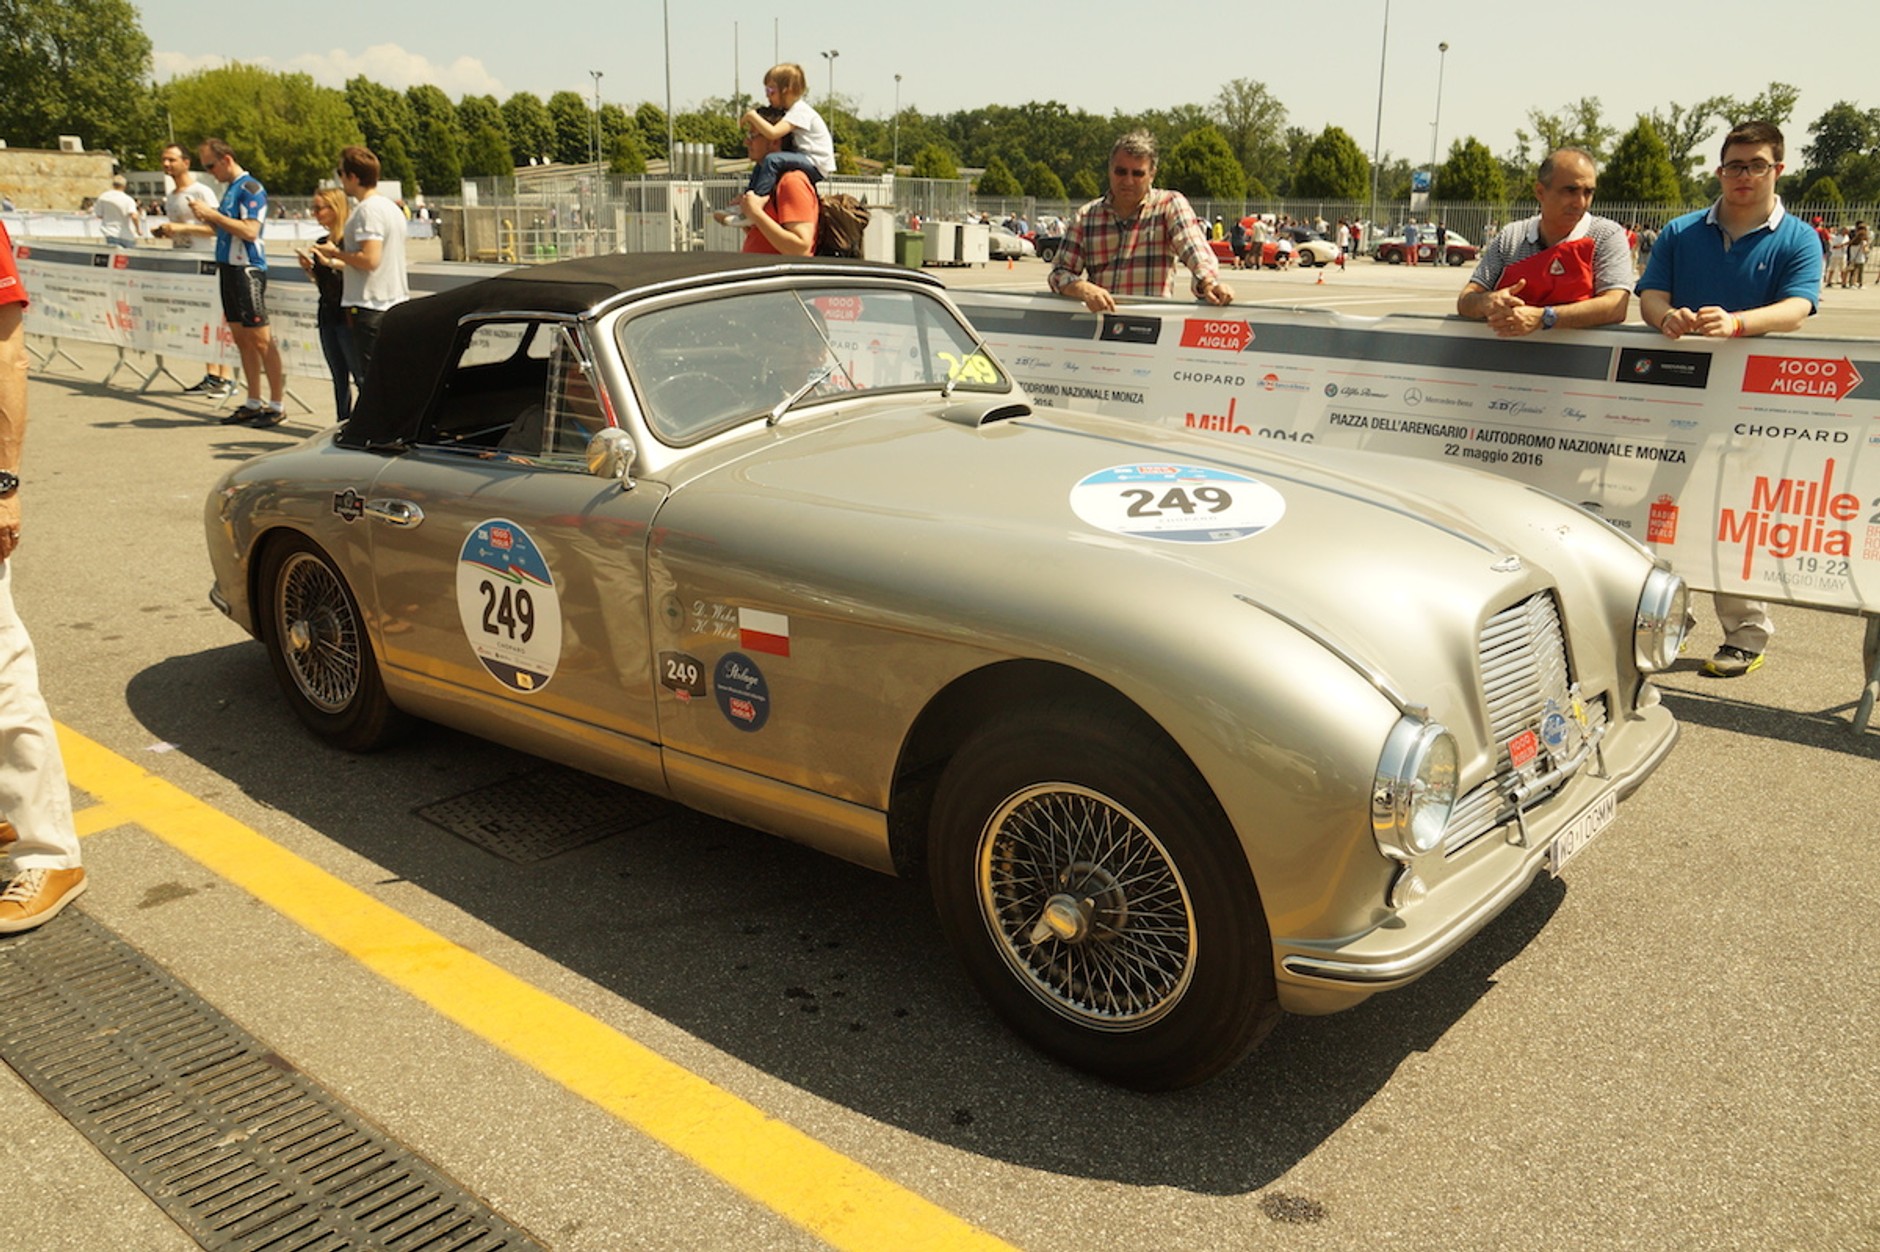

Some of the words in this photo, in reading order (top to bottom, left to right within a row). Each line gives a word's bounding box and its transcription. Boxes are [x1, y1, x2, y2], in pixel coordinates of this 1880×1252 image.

[828, 298, 854, 307] 1000
[1203, 322, 1241, 335] 1000
[1197, 336, 1240, 349] MIGLIA
[1173, 370, 1246, 387] CHOPARD
[1778, 360, 1838, 377] 1000
[1017, 380, 1060, 396] TODROMO
[1060, 385, 1110, 402] NAZIONALE
[1111, 390, 1144, 405] MONZA
[1770, 378, 1837, 396] MIGLIA
[1330, 412, 1369, 428] PIAZZA
[1371, 416, 1468, 440] DELL'ARENGARIO
[1475, 429, 1556, 450] AUTODROMO
[1558, 437, 1633, 458] NAZIONALE
[1635, 446, 1687, 464] MONZA
[1734, 422, 1849, 443] CHOPARD
[1444, 443, 1460, 457] 22
[1462, 446, 1508, 464] maggio
[1511, 451, 1543, 466] 2016
[1751, 457, 1861, 521] Mille
[1119, 486, 1233, 518] 249
[1652, 509, 1676, 520] RADIO
[1717, 507, 1852, 581] Miglia
[1796, 556, 1849, 577] 19-22
[1763, 571, 1813, 586] MAGGIO
[1818, 577, 1847, 591] MAY
[479, 579, 535, 644] 249
[666, 659, 699, 686] 249
